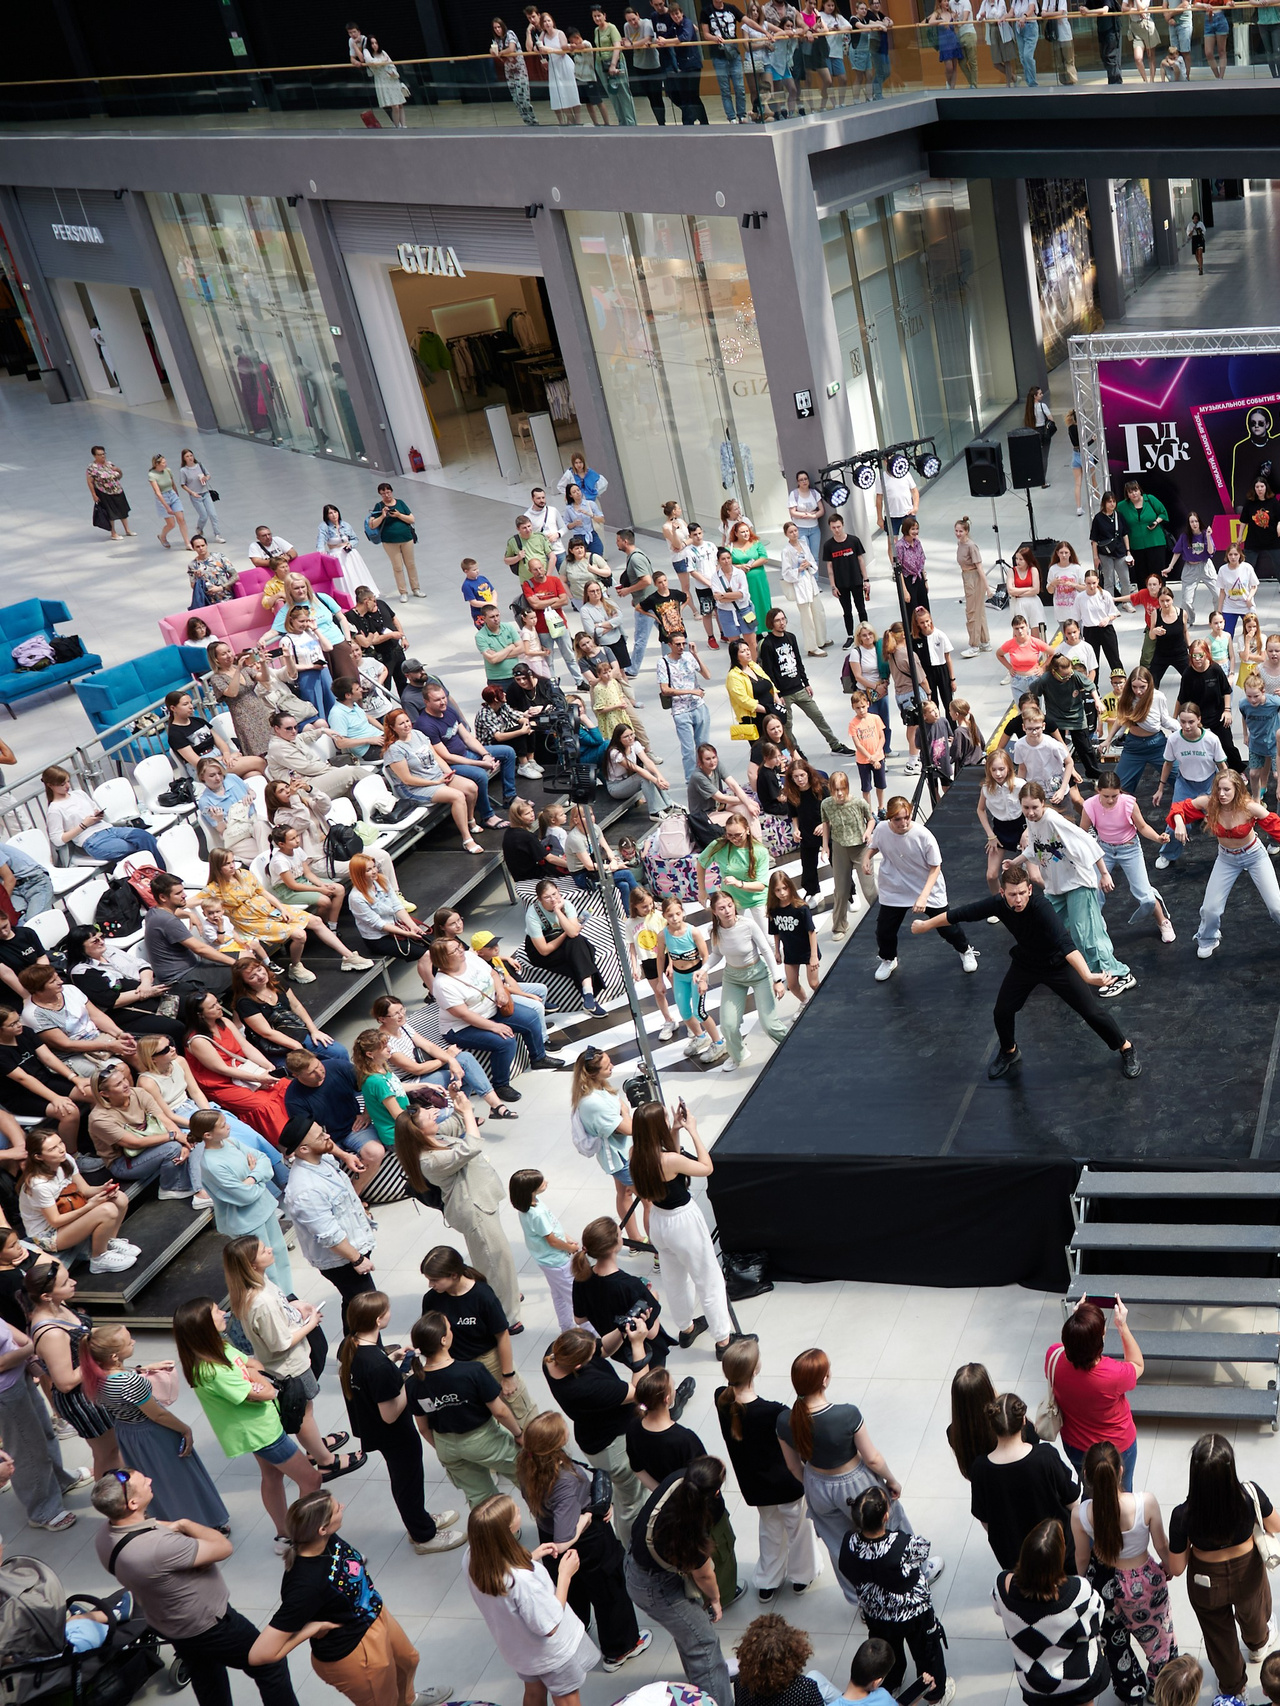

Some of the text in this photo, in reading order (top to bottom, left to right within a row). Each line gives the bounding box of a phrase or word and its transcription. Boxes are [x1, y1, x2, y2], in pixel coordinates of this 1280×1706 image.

[52, 224, 104, 243] PERSONA
[397, 242, 466, 278] GIZIA
[732, 376, 771, 397] GIZ
[1199, 400, 1245, 413] МУЗЫКАЛЬНОЕ
[1246, 394, 1276, 405] СОБЫТИЕ
[457, 1317, 477, 1325] AGR
[434, 1394, 459, 1407] AGR
